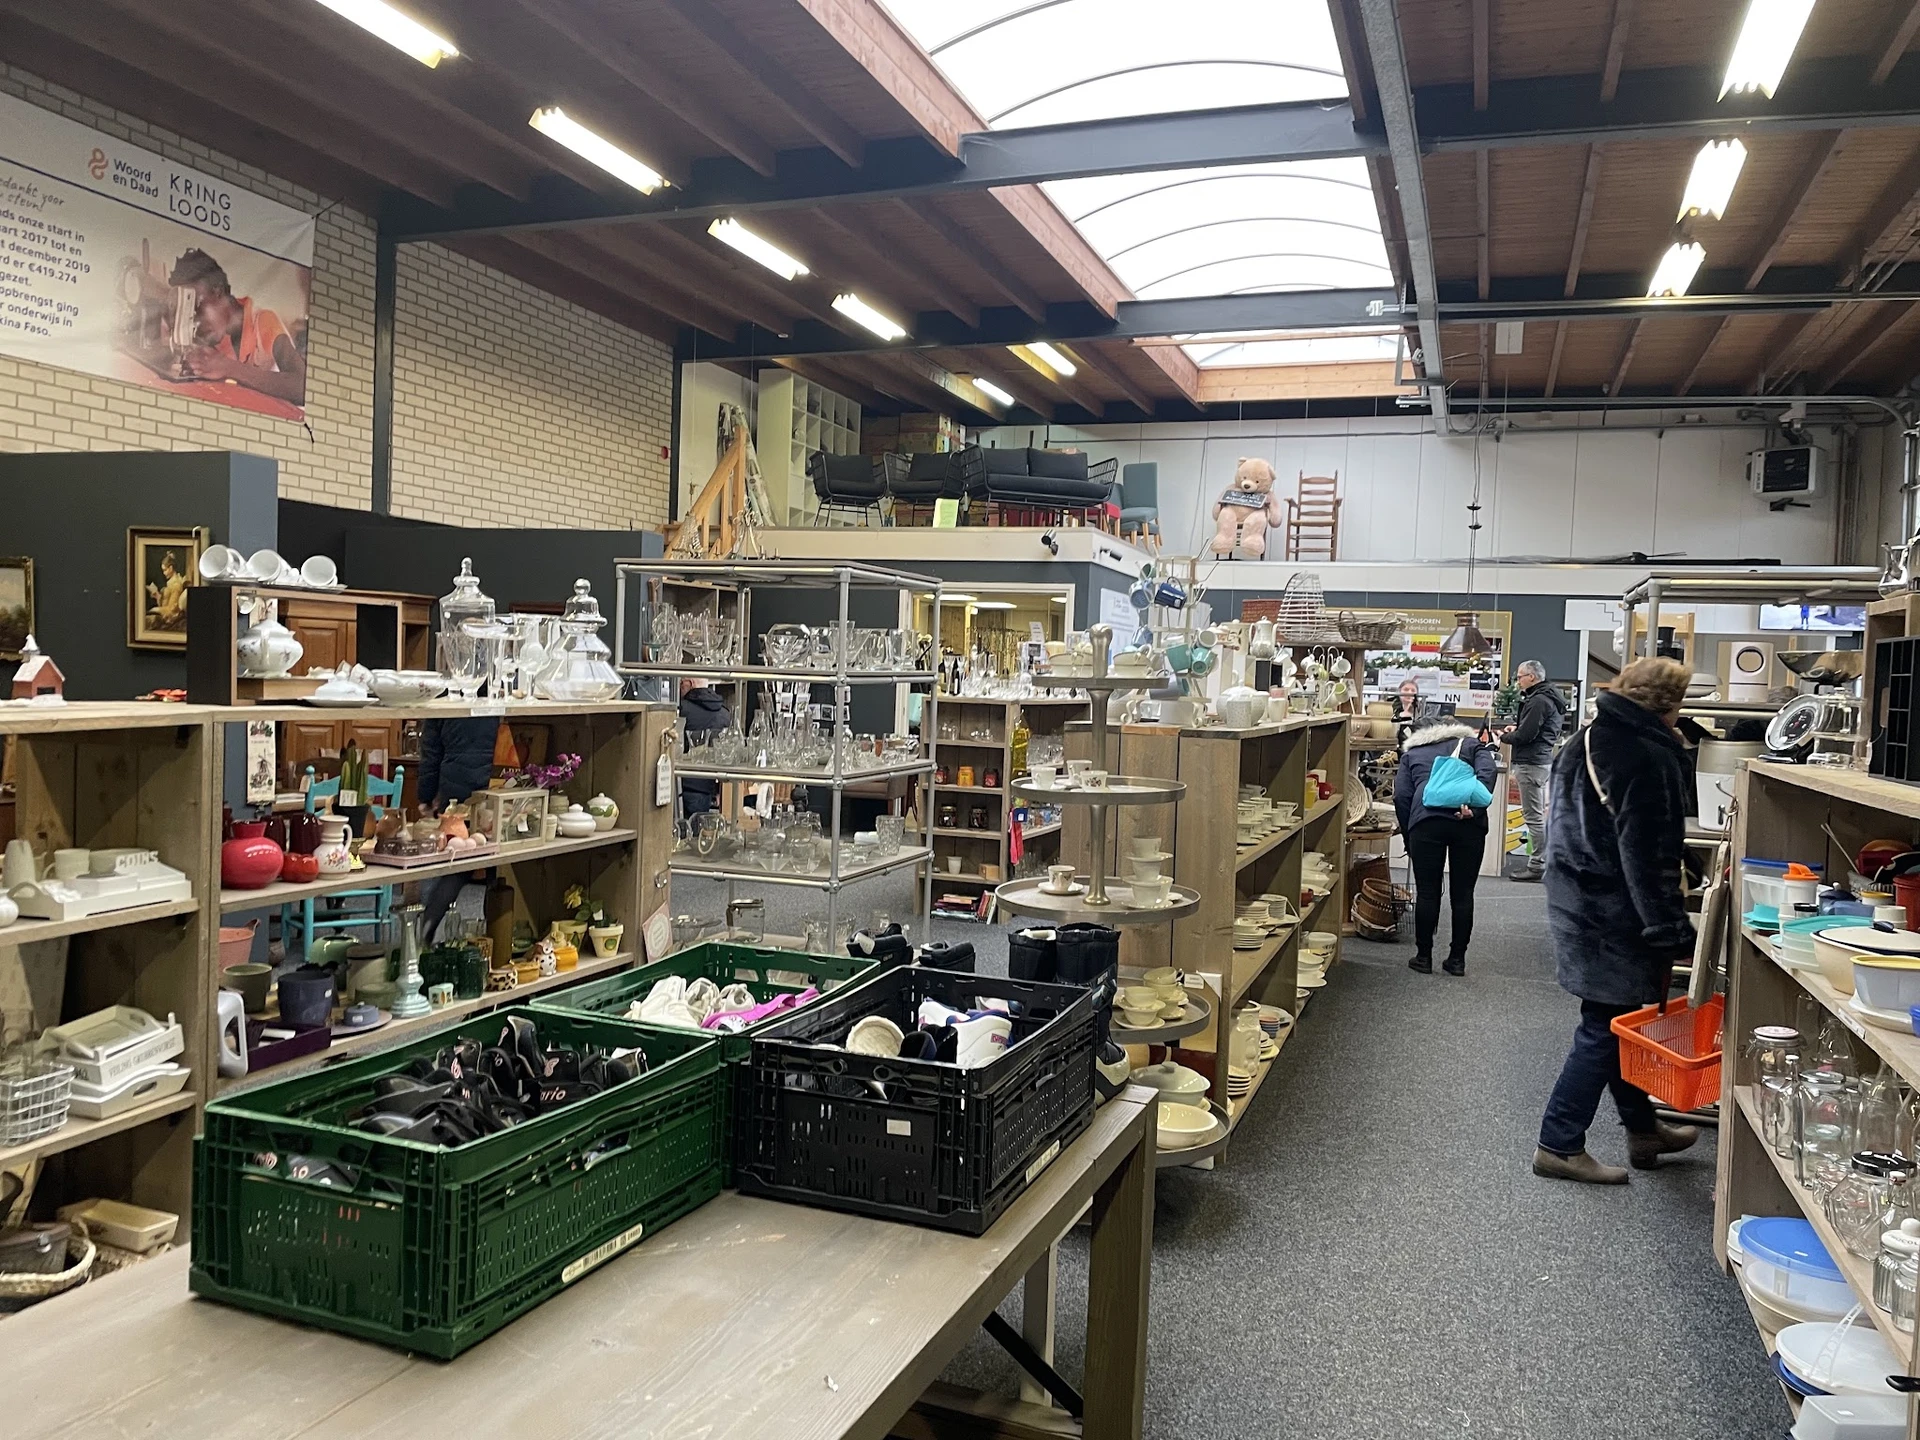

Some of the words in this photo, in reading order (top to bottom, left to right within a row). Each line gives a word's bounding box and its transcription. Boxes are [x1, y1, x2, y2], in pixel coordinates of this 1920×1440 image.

[113, 158, 151, 182] Woord
[112, 173, 127, 187] en
[130, 179, 159, 198] Daad
[170, 173, 231, 210] KRING
[169, 194, 231, 231] LOODS
[18, 215, 45, 230] onze
[47, 224, 73, 239] start
[75, 231, 86, 243] in
[21, 230, 48, 245] 2017
[51, 239, 66, 252] tot
[69, 246, 82, 256] en
[8, 242, 62, 265] december
[65, 258, 91, 274] 2019
[13, 259, 25, 269] er
[28, 263, 77, 284] €419.274
[7, 304, 60, 325] onderwijs
[62, 316, 73, 327] in
[56, 302, 79, 317] ging
[24, 322, 52, 337] Faso.
[1444, 693, 1461, 703] NN
[1474, 698, 1489, 708] logo
